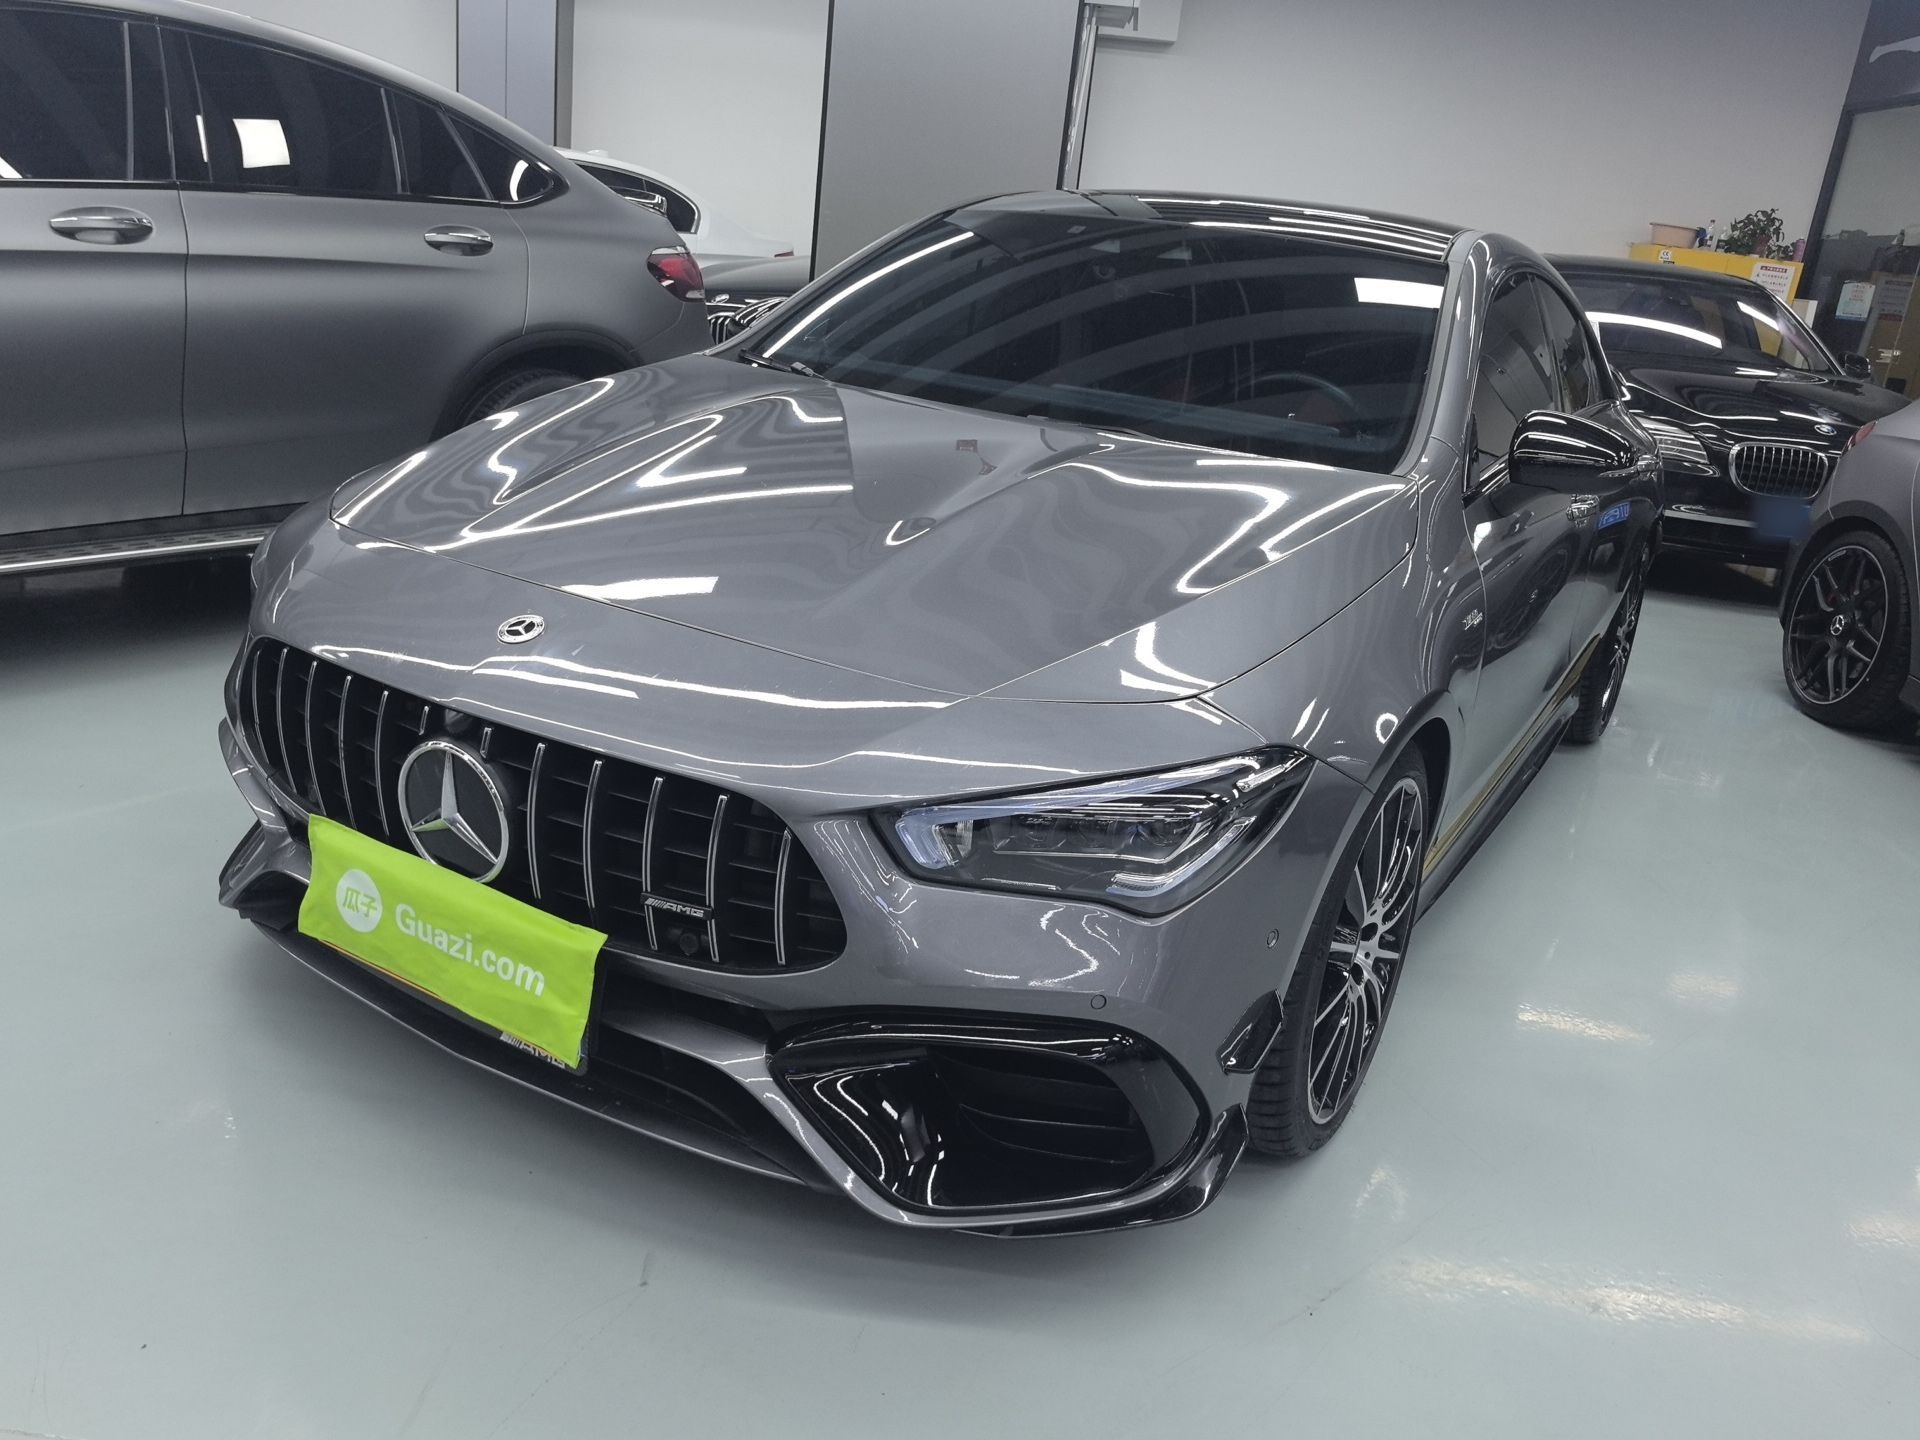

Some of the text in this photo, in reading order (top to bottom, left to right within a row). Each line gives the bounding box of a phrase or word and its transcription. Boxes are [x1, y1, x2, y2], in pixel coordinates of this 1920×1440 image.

[343, 886, 378, 918] 瓜子
[662, 901, 705, 917] AMG
[395, 903, 545, 997] Guazi.com
